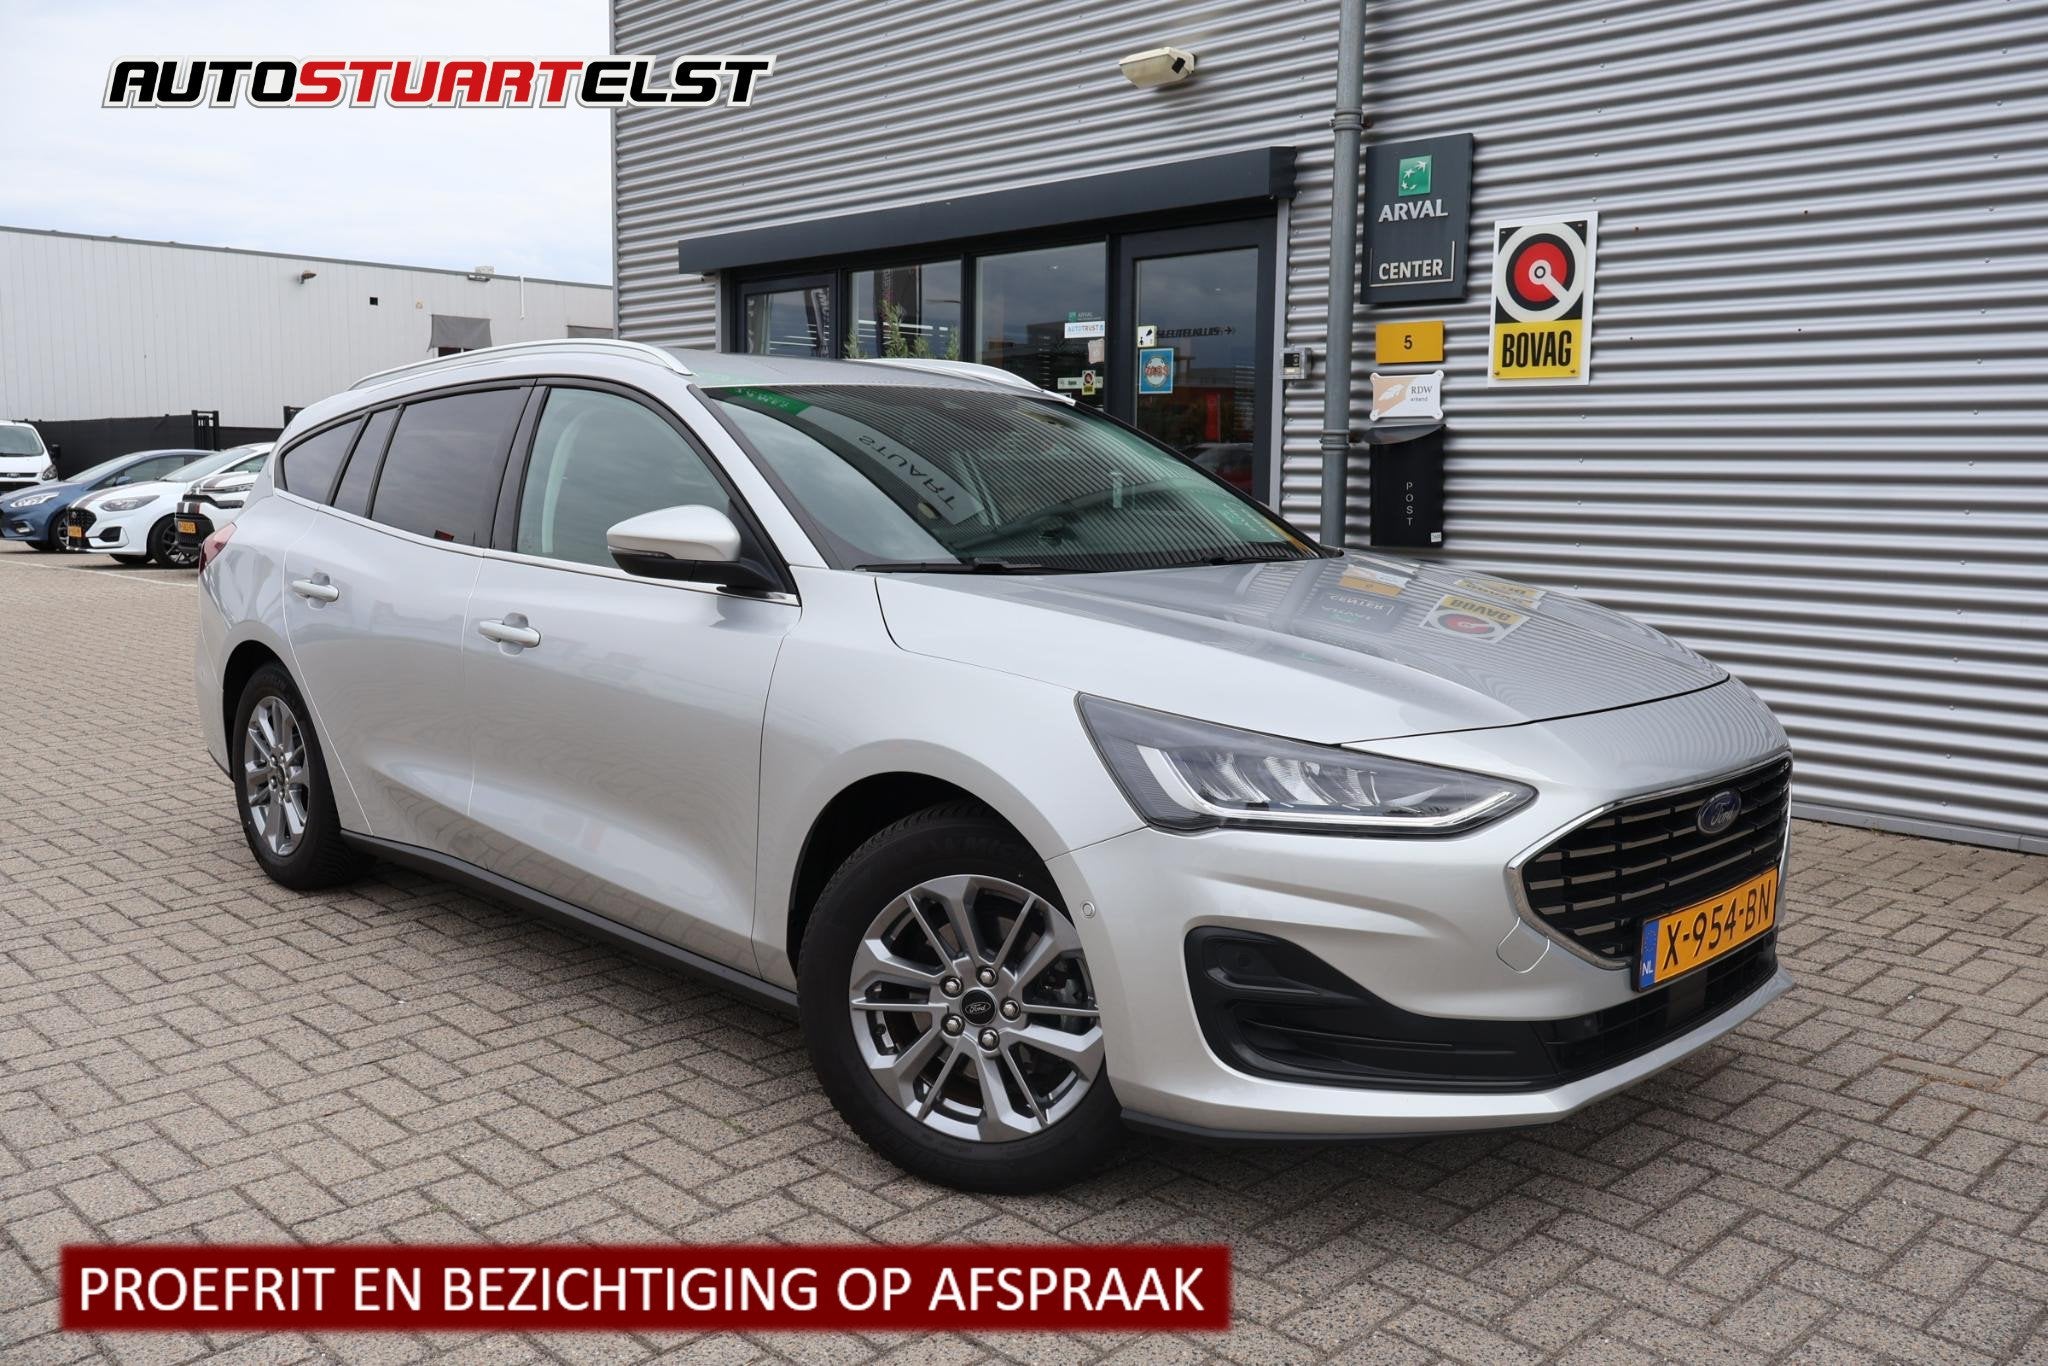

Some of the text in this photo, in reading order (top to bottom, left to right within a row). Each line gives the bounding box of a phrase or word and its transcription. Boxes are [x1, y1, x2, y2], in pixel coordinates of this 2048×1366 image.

[1378, 198, 1448, 222] ARVAL
[1378, 258, 1443, 280] CENTER
[1403, 334, 1413, 350] 5
[1501, 329, 1572, 368] BOVAG
[1411, 385, 1433, 395] RDW
[1405, 481, 1414, 526] POST
[1663, 879, 1772, 970] X-954-BN
[1642, 960, 1654, 976] NL
